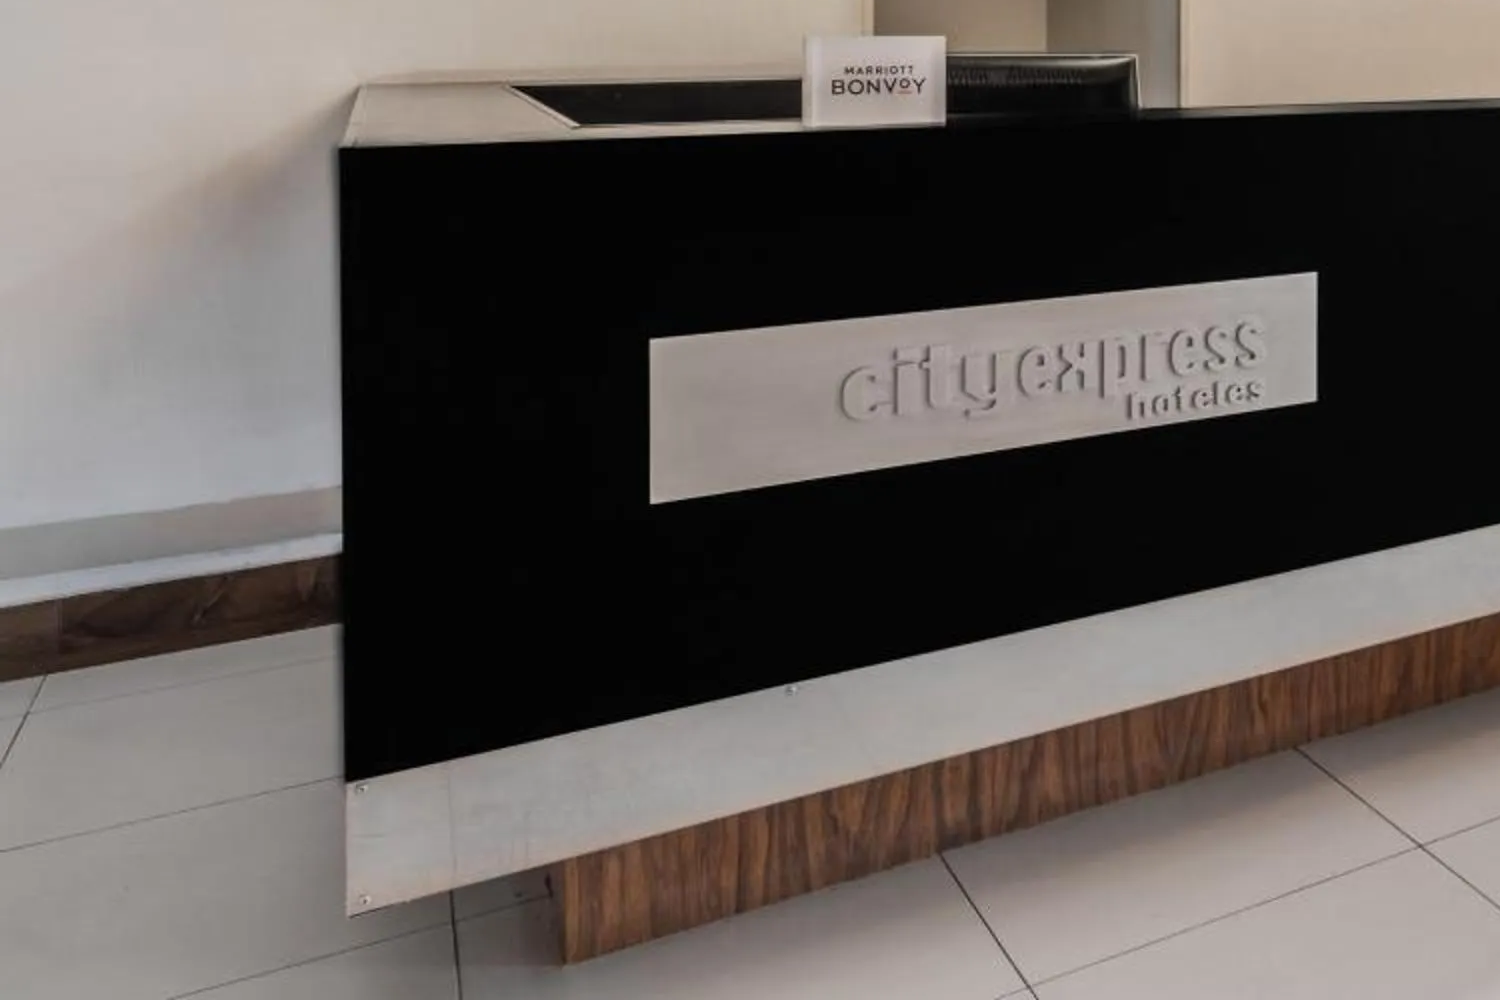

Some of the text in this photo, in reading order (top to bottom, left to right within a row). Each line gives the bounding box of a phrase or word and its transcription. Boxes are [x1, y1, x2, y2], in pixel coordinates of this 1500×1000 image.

[844, 65, 914, 75] MARRIOTT
[831, 77, 926, 95] BONVOY
[1125, 380, 1263, 420] hoteles
